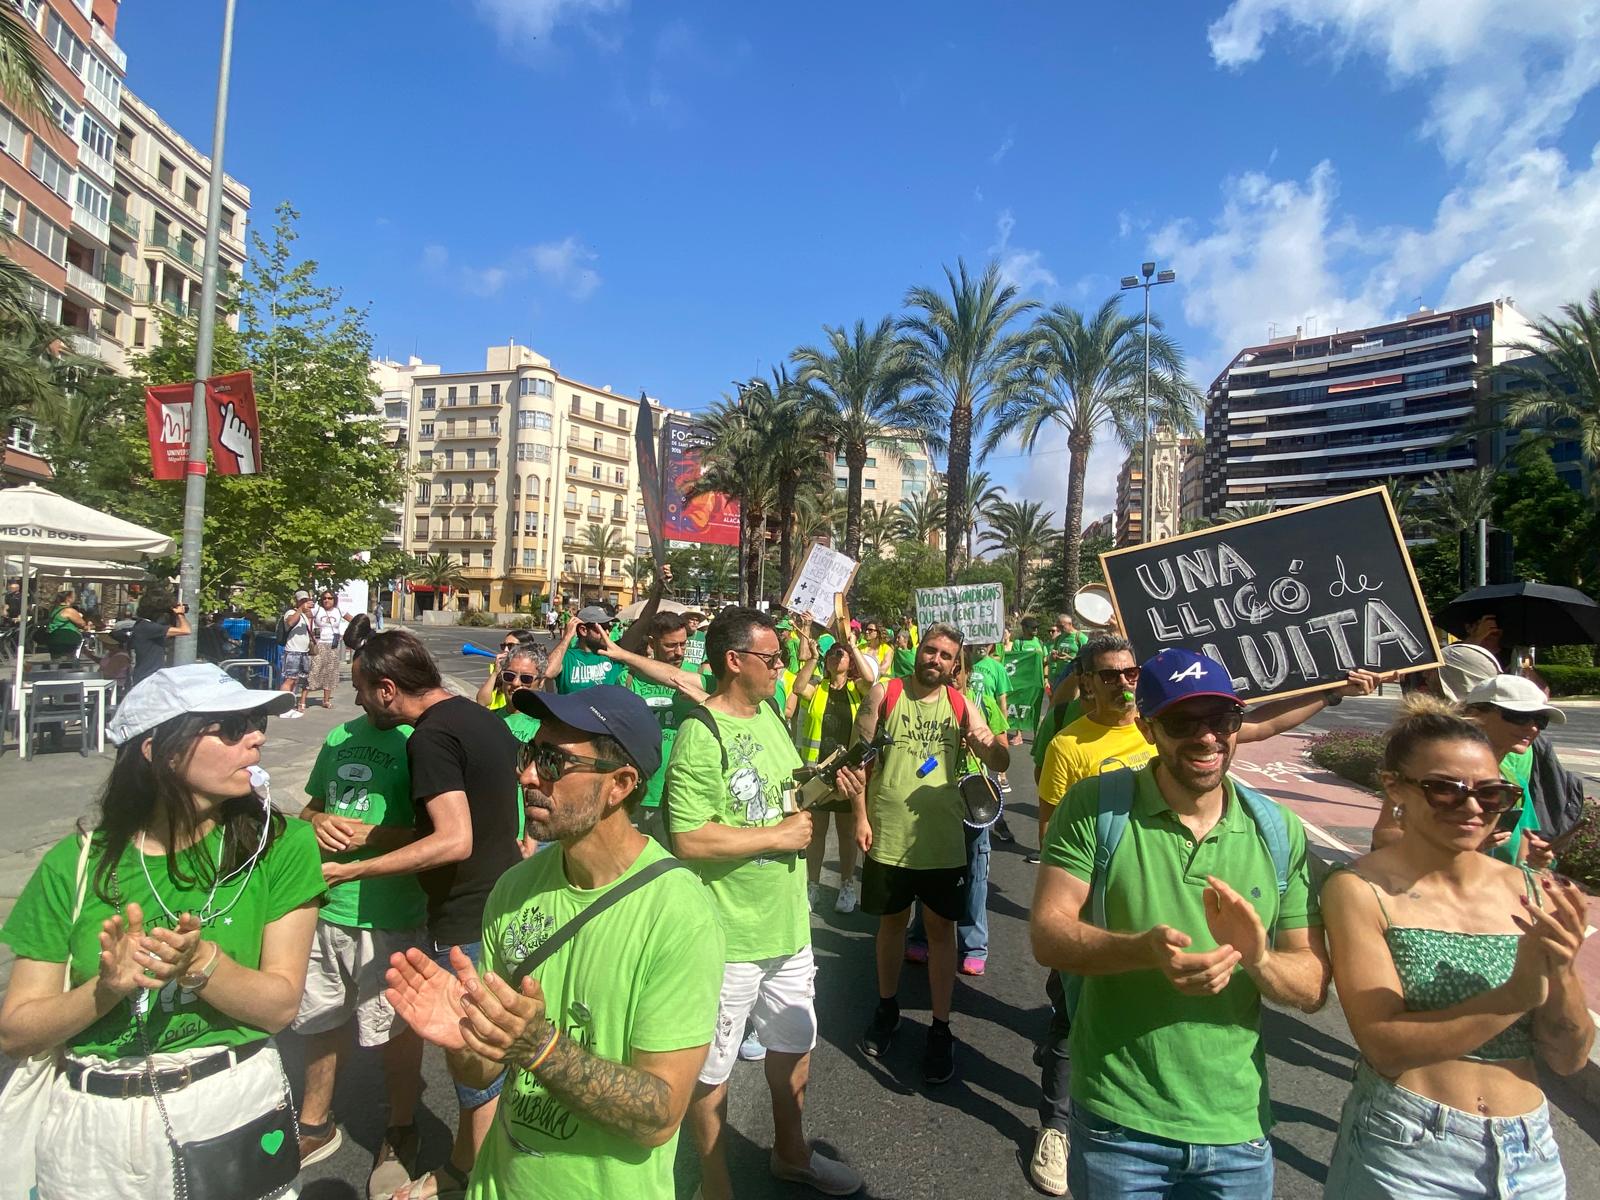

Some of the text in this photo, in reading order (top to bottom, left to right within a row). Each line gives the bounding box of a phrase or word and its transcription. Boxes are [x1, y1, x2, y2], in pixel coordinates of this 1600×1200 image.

[47, 530, 87, 541] BOSS
[1136, 542, 1256, 600] UNA
[1147, 555, 1384, 642] LLIÇÓ de
[1203, 598, 1425, 692] LUITA
